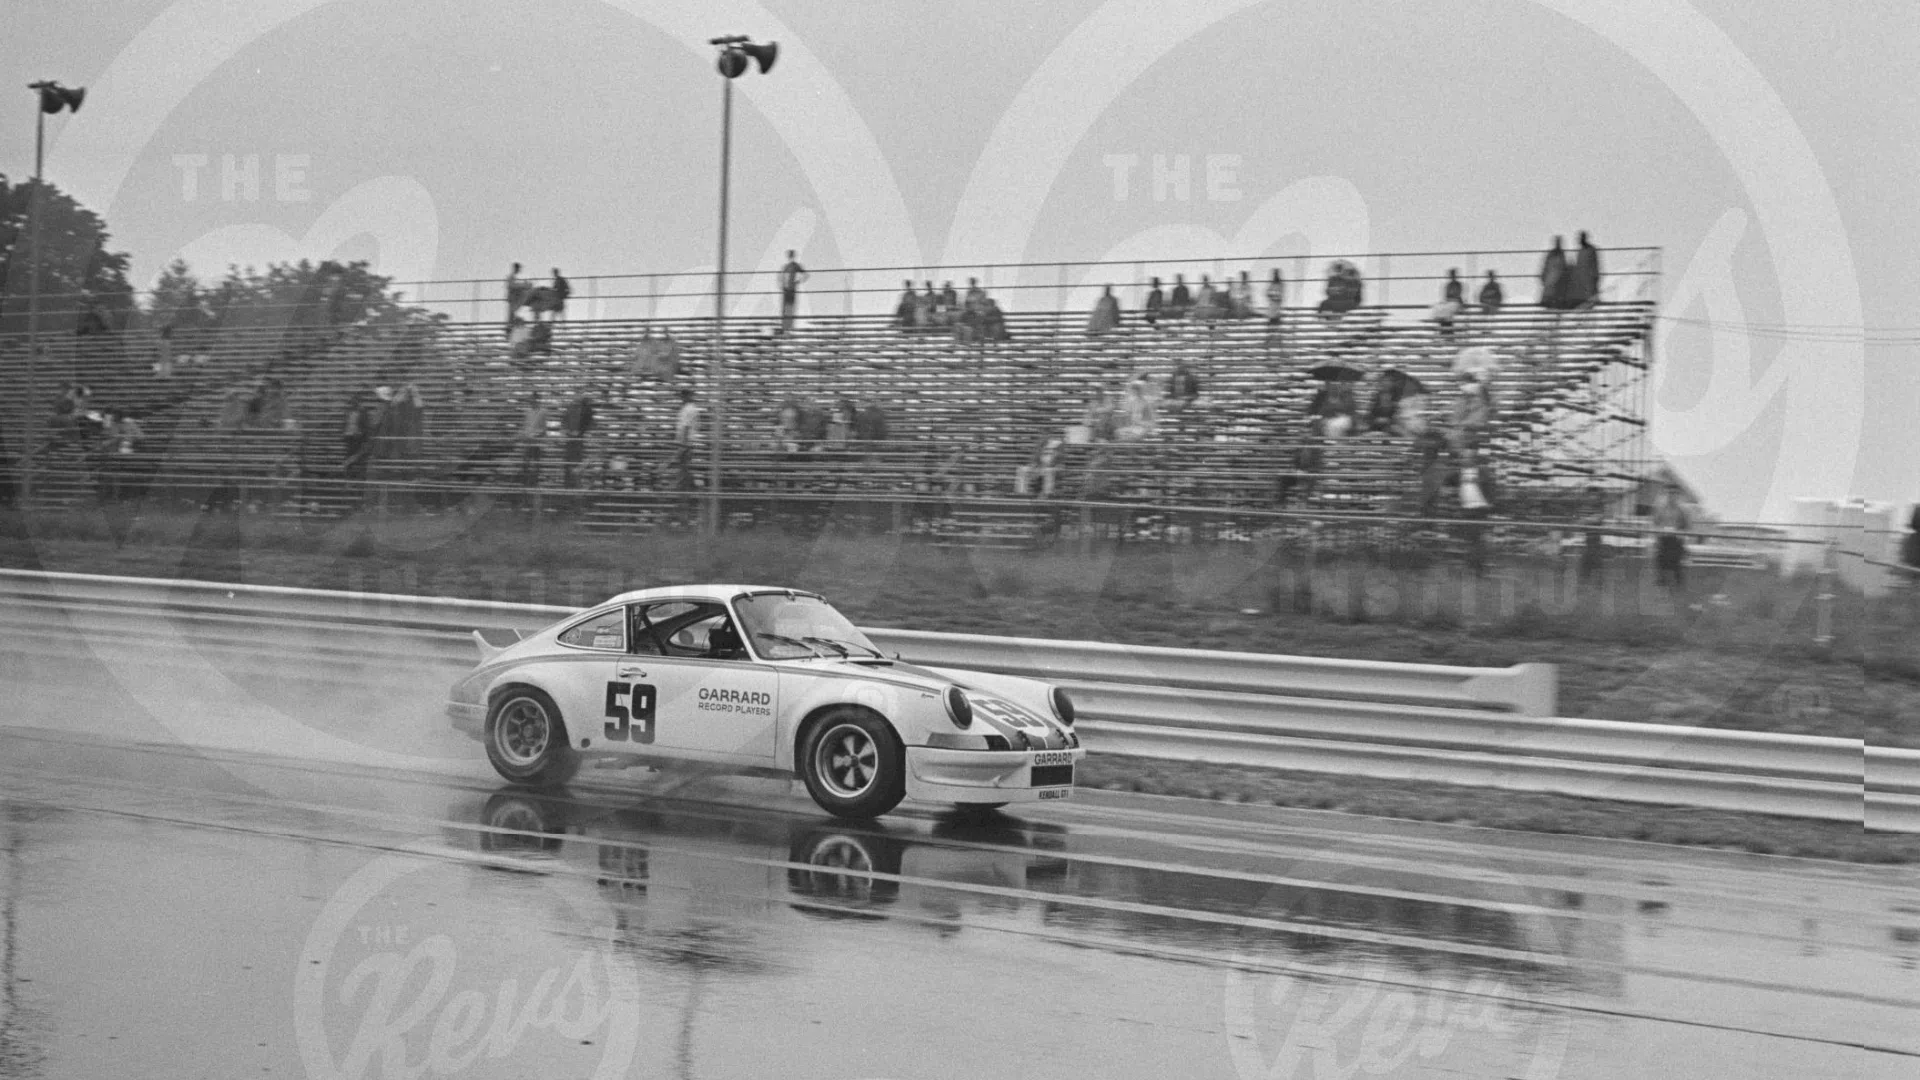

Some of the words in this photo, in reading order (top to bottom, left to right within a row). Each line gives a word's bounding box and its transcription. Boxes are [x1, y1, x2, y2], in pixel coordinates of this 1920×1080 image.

[699, 688, 771, 706] GARRARD
[604, 681, 657, 745] 59
[699, 702, 733, 713] RECORD
[735, 705, 771, 716] PLAYERS
